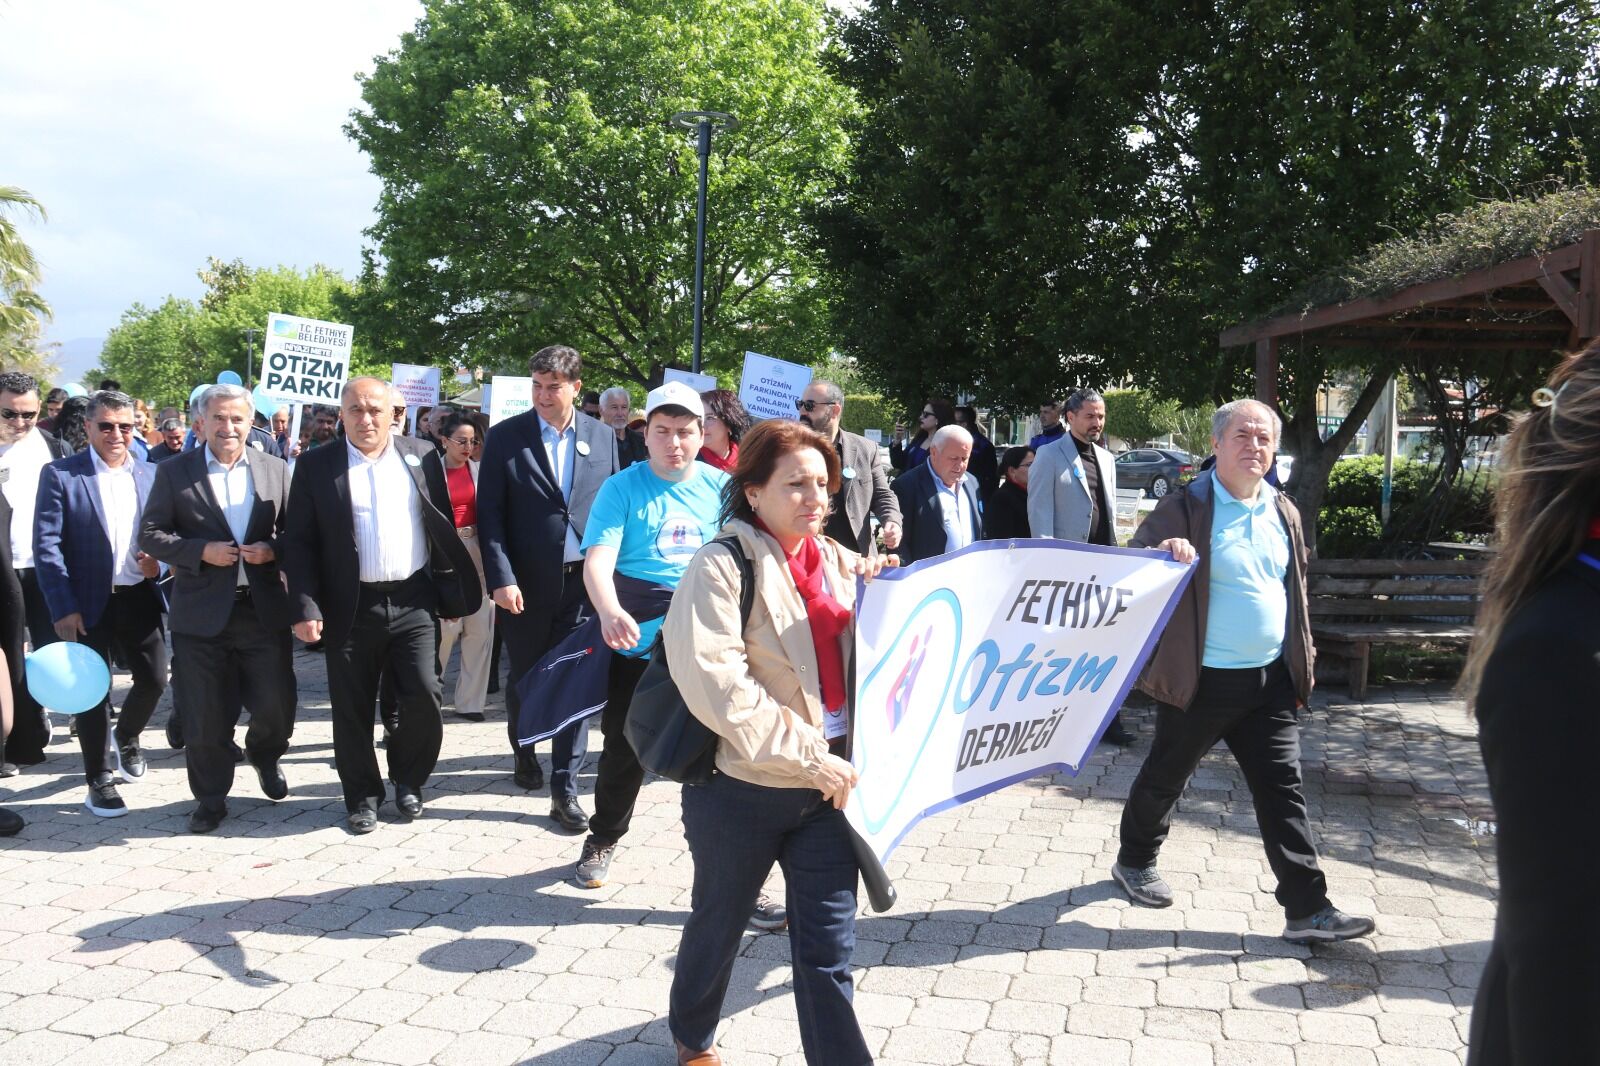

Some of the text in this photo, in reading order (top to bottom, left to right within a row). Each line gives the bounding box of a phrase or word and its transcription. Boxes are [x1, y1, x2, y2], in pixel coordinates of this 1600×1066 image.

[298, 332, 346, 347] BELEDİYESİ
[300, 324, 348, 338] T.C. FETHİYE
[270, 352, 344, 380] OTİZM
[266, 372, 340, 399] PARKI
[760, 377, 792, 390] OTİZMİN
[756, 396, 790, 410] ONLARIN
[1005, 574, 1134, 629] FETHİYE
[952, 639, 1118, 714] Otizm
[956, 706, 1067, 772] DERNEĞİ
